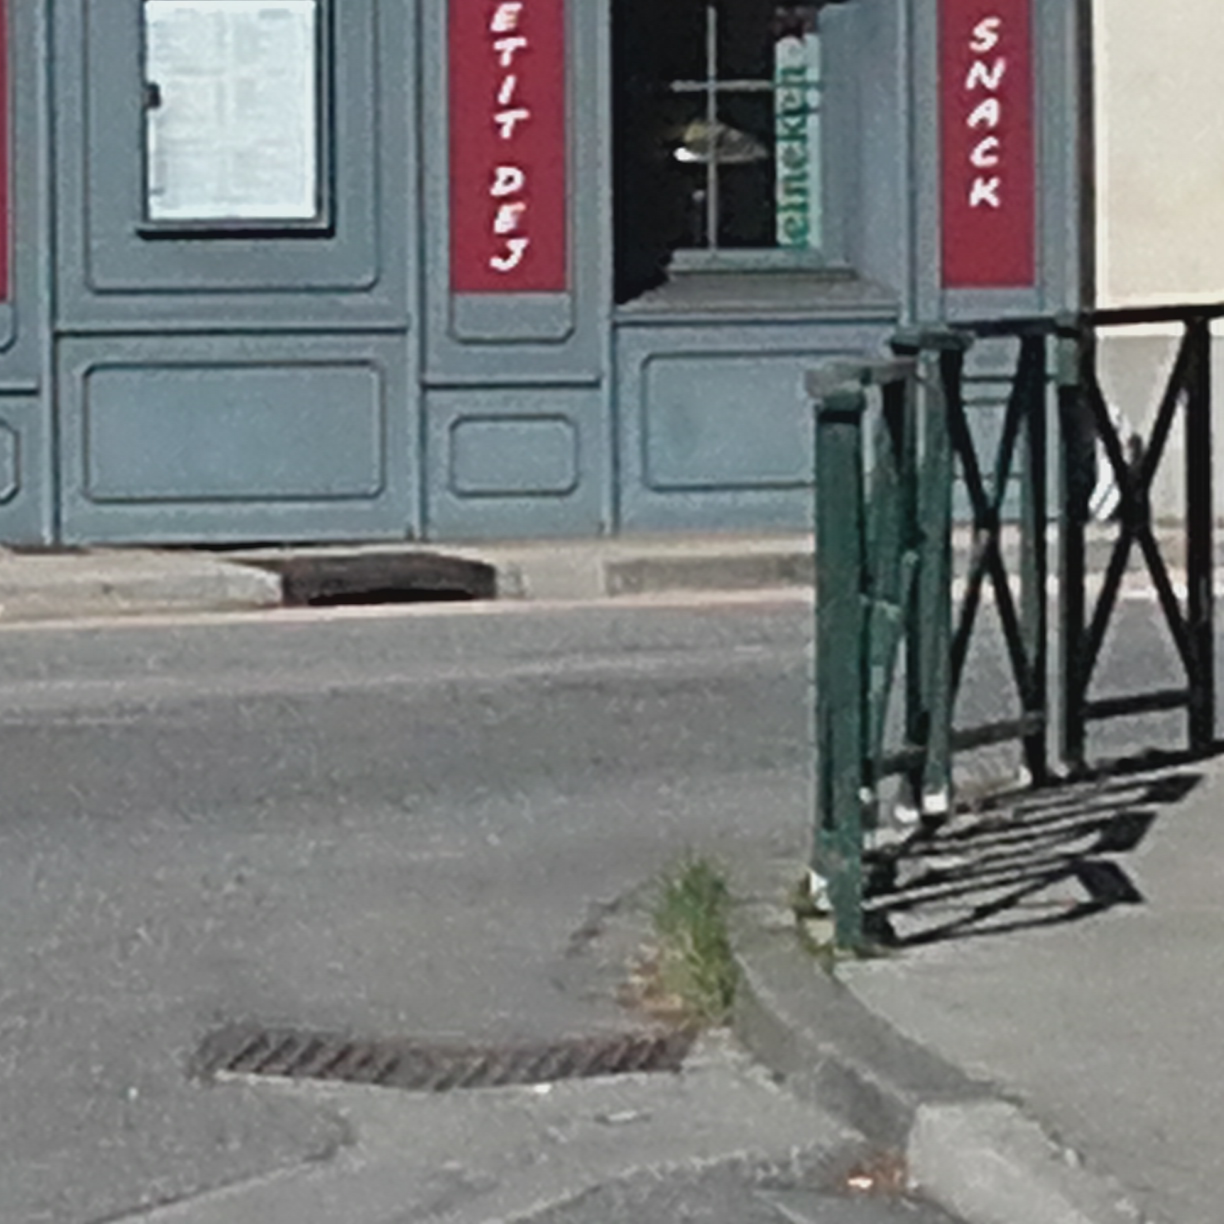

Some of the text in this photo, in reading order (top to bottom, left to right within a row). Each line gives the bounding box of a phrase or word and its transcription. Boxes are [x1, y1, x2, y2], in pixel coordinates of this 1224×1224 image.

[776, 65, 809, 249] eineken
[965, 17, 1006, 208] SNACK
[489, 165, 529, 271] DEJ
